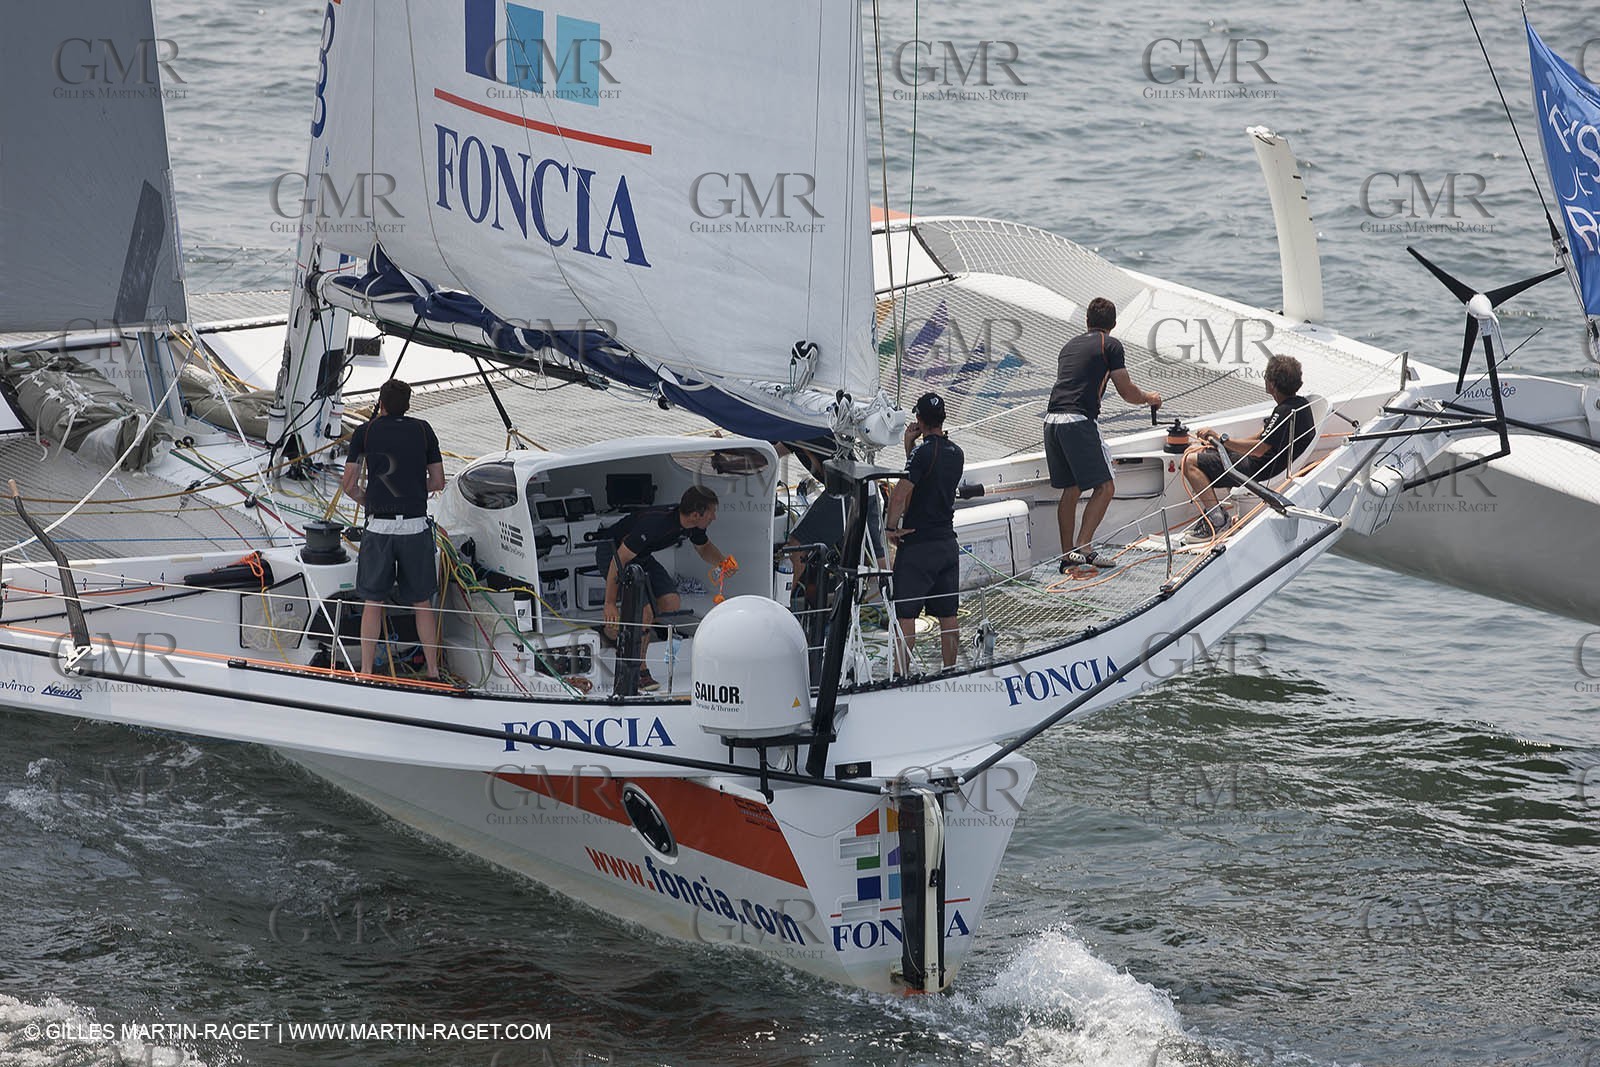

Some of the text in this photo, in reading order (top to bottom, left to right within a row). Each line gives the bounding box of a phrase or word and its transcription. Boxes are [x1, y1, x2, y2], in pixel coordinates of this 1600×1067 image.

[434, 123, 652, 268] FONCIA
[695, 681, 740, 705] SAILOR
[1002, 656, 1127, 707] FONCIA
[502, 716, 676, 752] FONCIA
[831, 909, 970, 952] FONA
